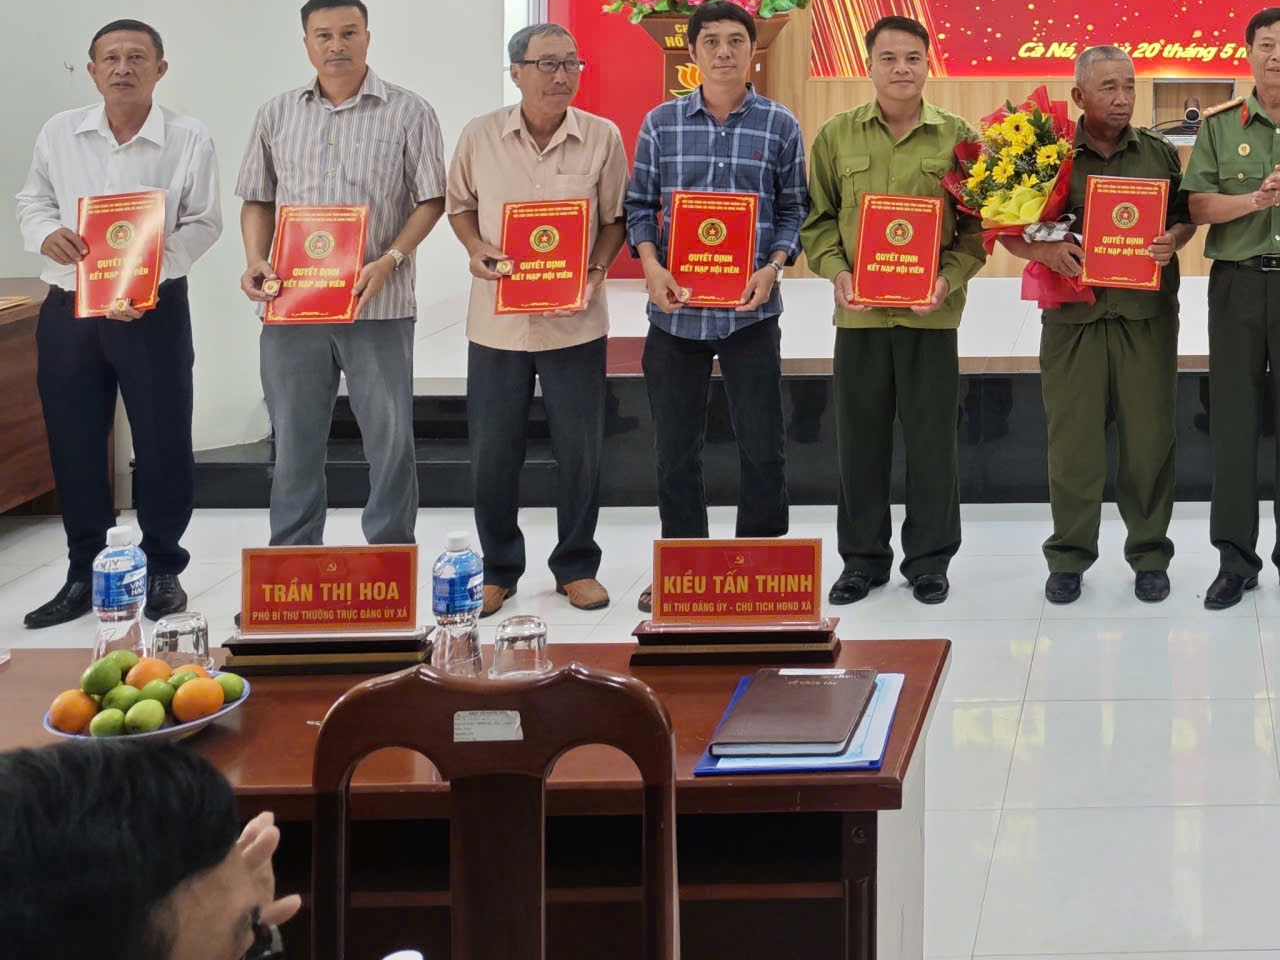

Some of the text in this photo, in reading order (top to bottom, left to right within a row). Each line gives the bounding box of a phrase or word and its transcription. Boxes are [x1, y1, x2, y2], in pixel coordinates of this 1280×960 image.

[1018, 42, 1045, 58] Cà
[1045, 42, 1078, 59] Ná,
[1132, 42, 1161, 58] 20
[1162, 43, 1218, 62] tháng
[1220, 43, 1236, 59] 5
[1102, 235, 1125, 244] QUYẾT
[688, 252, 712, 262] QUYẾT
[875, 252, 898, 262] QUYẾT
[520, 259, 544, 270] QUYẾT
[713, 569, 748, 594] TẤN
[755, 574, 813, 597] THỊNH
[320, 582, 352, 605] THỊ
[359, 581, 399, 601] HOA
[692, 600, 714, 612] ĐẢNG
[736, 599, 753, 612] CHỦ
[755, 601, 774, 613] TỊCH
[302, 607, 334, 620] THƯỜNG
